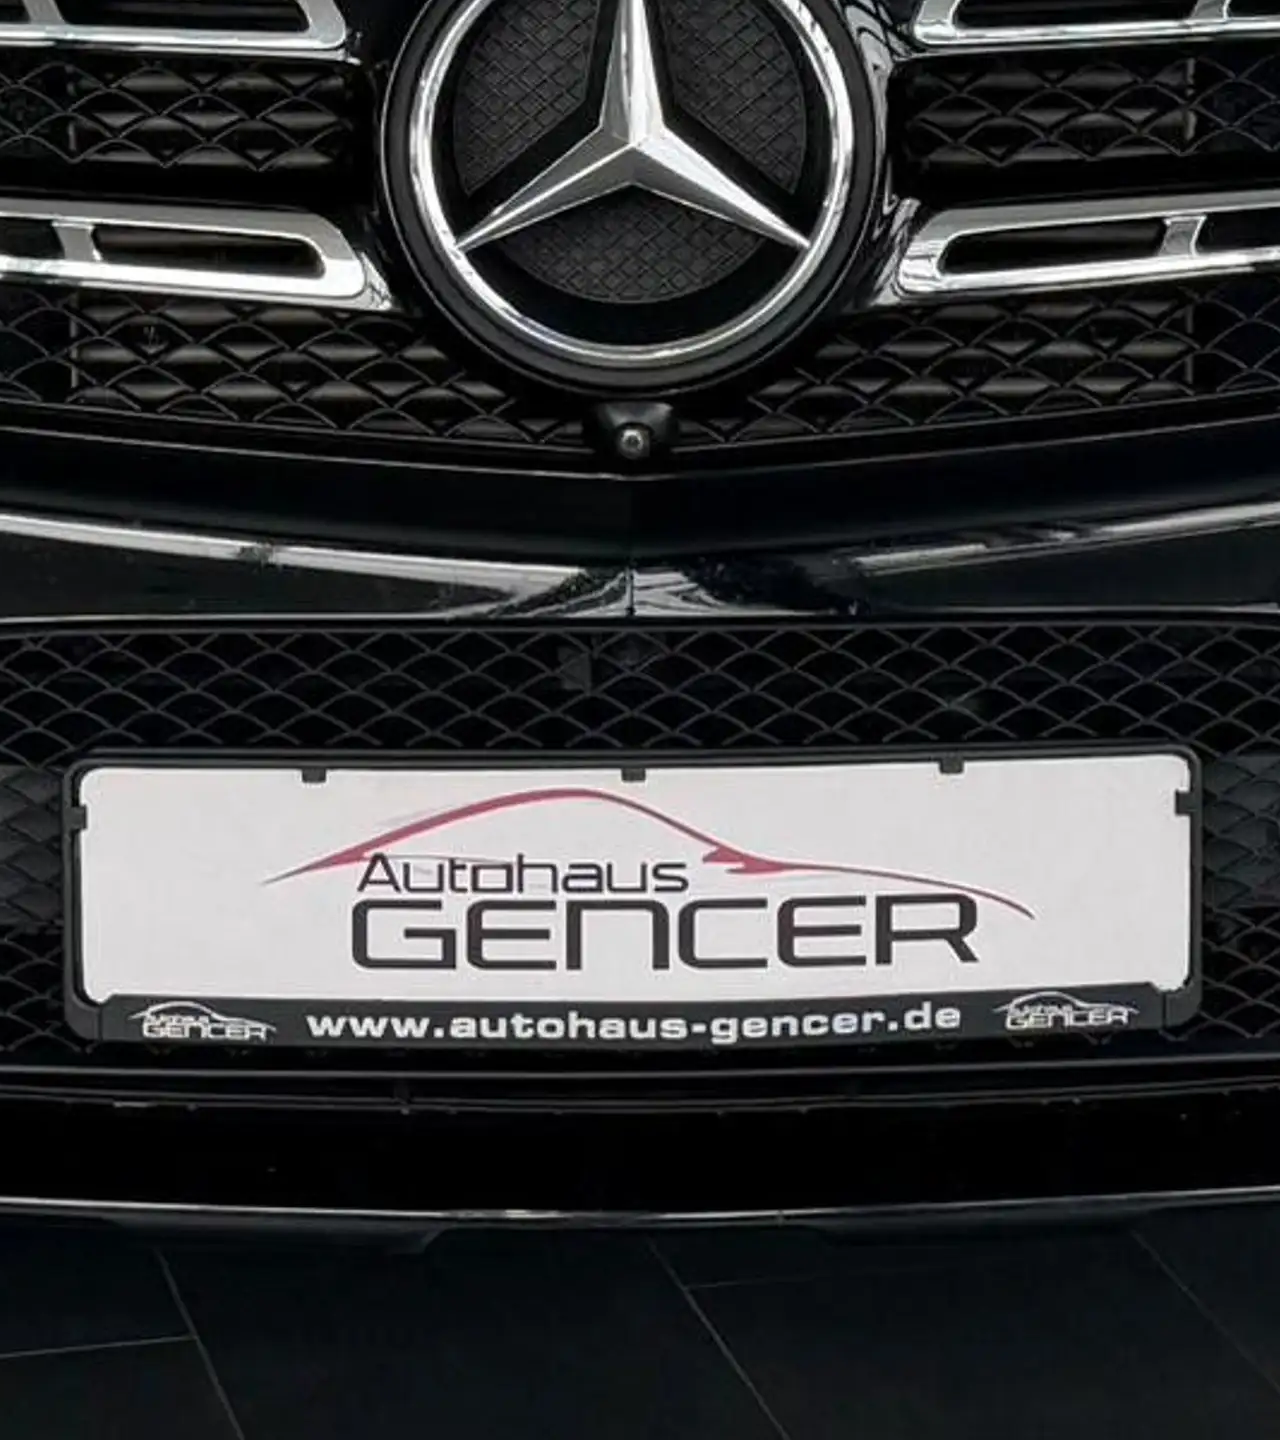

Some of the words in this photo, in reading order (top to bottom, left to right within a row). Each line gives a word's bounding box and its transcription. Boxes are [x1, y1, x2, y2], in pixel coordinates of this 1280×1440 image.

[356, 853, 689, 893] Autohaus
[350, 893, 979, 971] GENCER
[142, 1022, 267, 1041] GENCER
[305, 1001, 962, 1044] www.autohaus-gencer.de
[1005, 1007, 1129, 1031] GENCER
